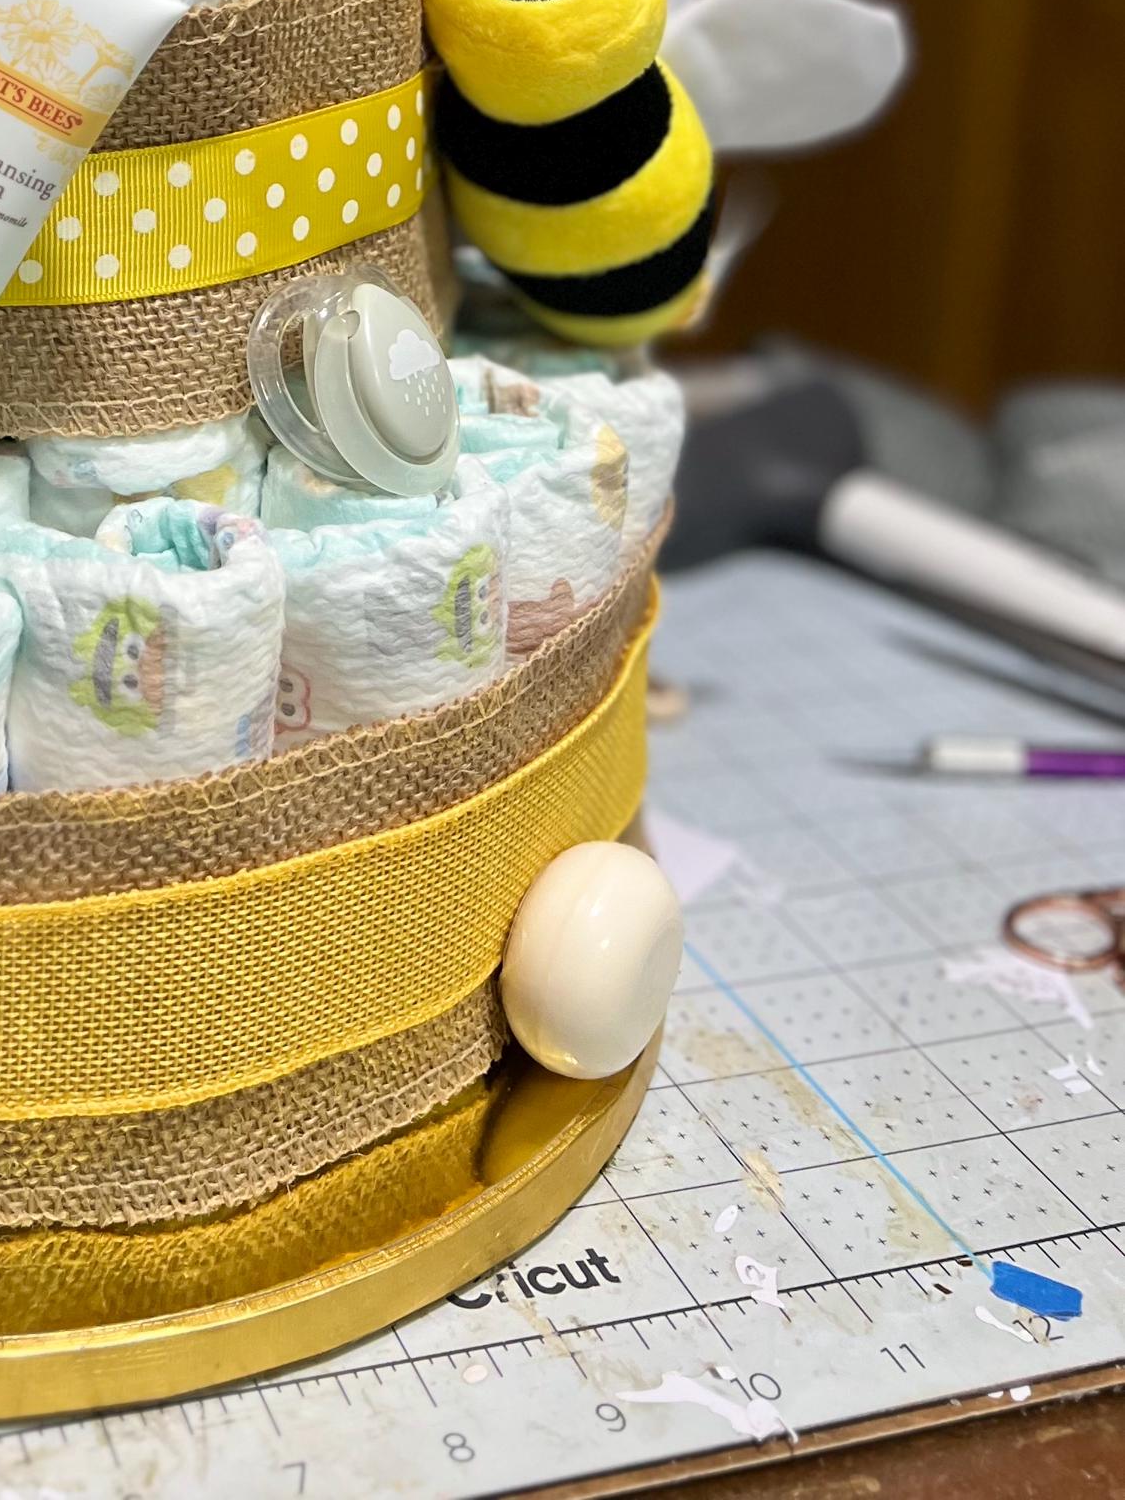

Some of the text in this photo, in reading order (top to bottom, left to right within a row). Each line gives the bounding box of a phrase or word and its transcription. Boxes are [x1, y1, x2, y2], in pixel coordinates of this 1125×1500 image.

[880, 1344, 925, 1372] 11
[595, 1403, 626, 1432] 9
[443, 1432, 475, 1462] 8
[282, 1461, 306, 1495] 7
